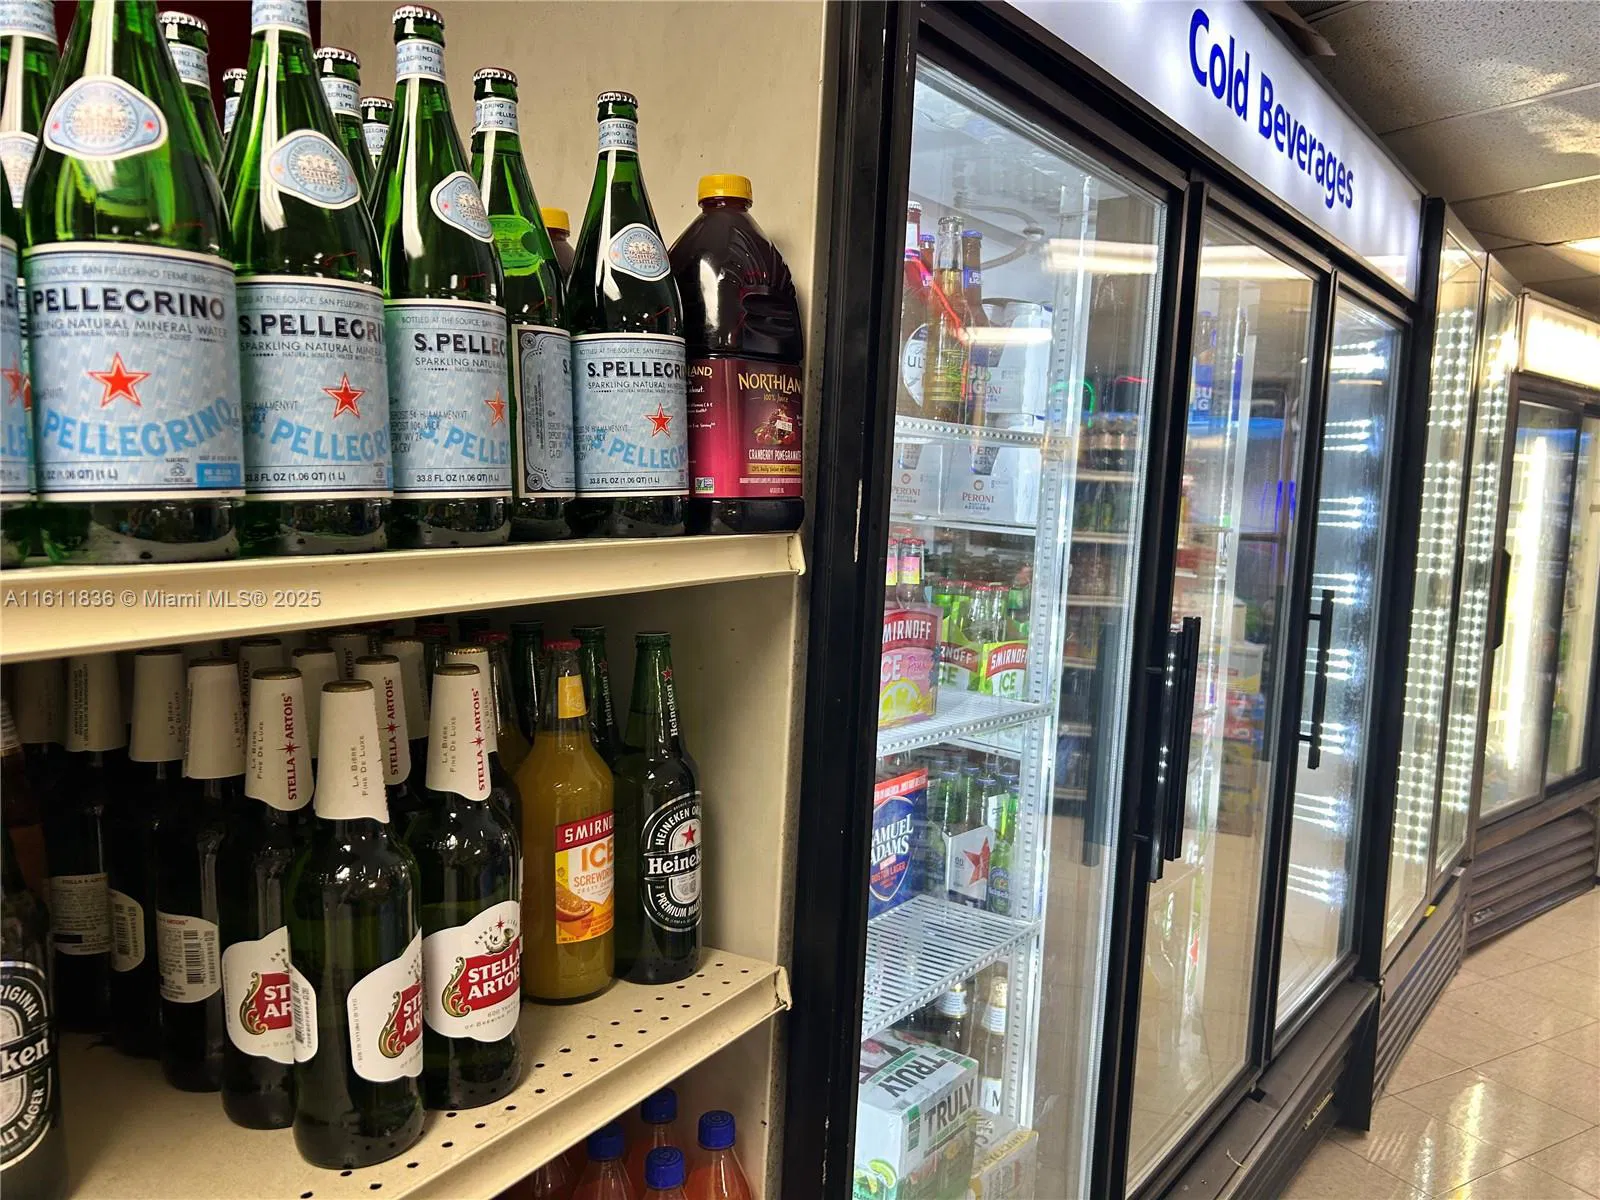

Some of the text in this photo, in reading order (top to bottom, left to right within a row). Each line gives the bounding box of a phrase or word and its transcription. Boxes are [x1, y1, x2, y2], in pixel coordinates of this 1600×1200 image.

[1189, 8, 1353, 209] Cold Beverages
[68, 319, 228, 339] NATURAL MINERAL WATER
[240, 342, 353, 353] SPARKLING NATURAL
[415, 358, 469, 366] SPARKLING
[588, 381, 630, 389] SPARKLING
[632, 381, 666, 389] NATURAL
[44, 396, 232, 457] PELLEGRINO
[962, 491, 994, 503] PERONI
[883, 619, 932, 645] MIRNOFF
[880, 653, 903, 683] CE
[601, 675, 613, 726] Heineken
[666, 684, 679, 737] Heineken
[385, 679, 399, 776] STELLA ARTOIS
[472, 689, 485, 792] STELLA ARTOIS
[283, 695, 297, 801] STELLA ARTOIS
[655, 808, 690, 846] HEINEKEN
[873, 813, 914, 845] AMUEL
[581, 839, 613, 872] ICE
[656, 892, 687, 918] PREMIUM
[468, 948, 520, 983] STELLA
[468, 962, 520, 1001] ARTOIS
[878, 1054, 948, 1098] TRULY
[18, 1087, 45, 1131] LAGER
[924, 1079, 975, 1138] TRULY
